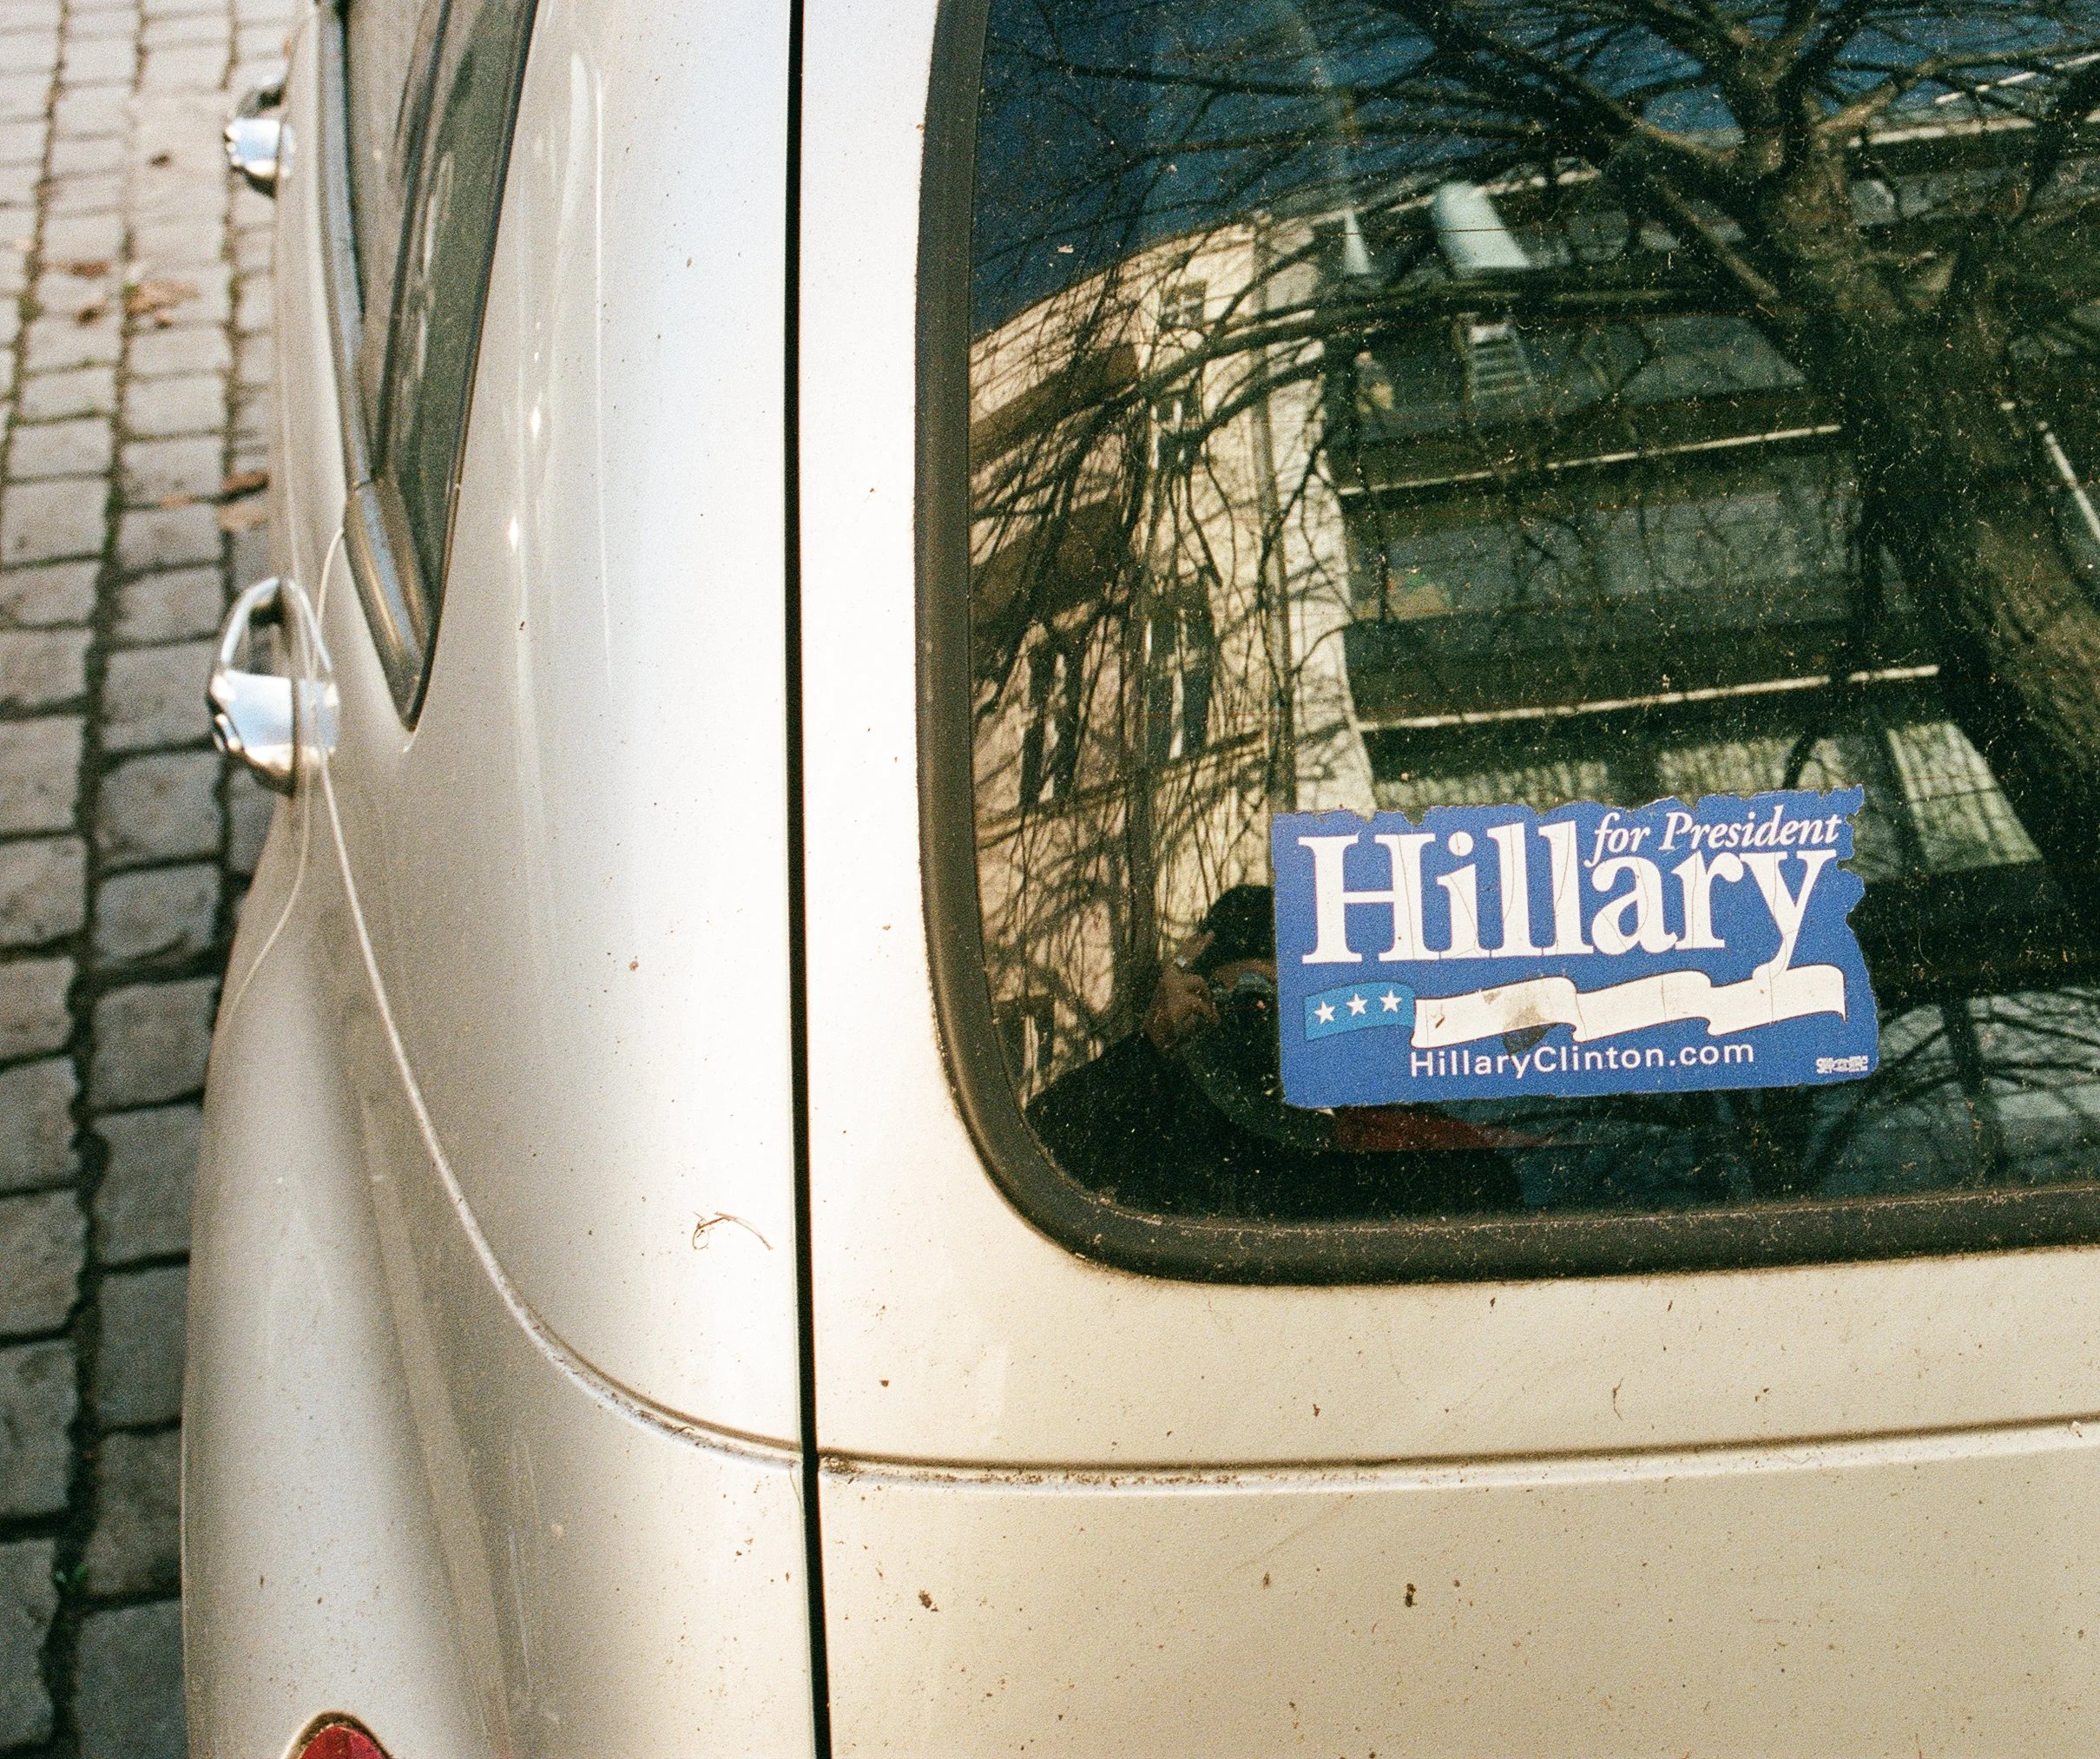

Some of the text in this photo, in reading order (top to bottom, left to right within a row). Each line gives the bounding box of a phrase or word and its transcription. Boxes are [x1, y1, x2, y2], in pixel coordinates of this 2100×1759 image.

[1584, 805, 1842, 868] for President
[1298, 820, 1838, 980] Hillary
[1410, 1039, 1755, 1079] HillaryClinton.com
